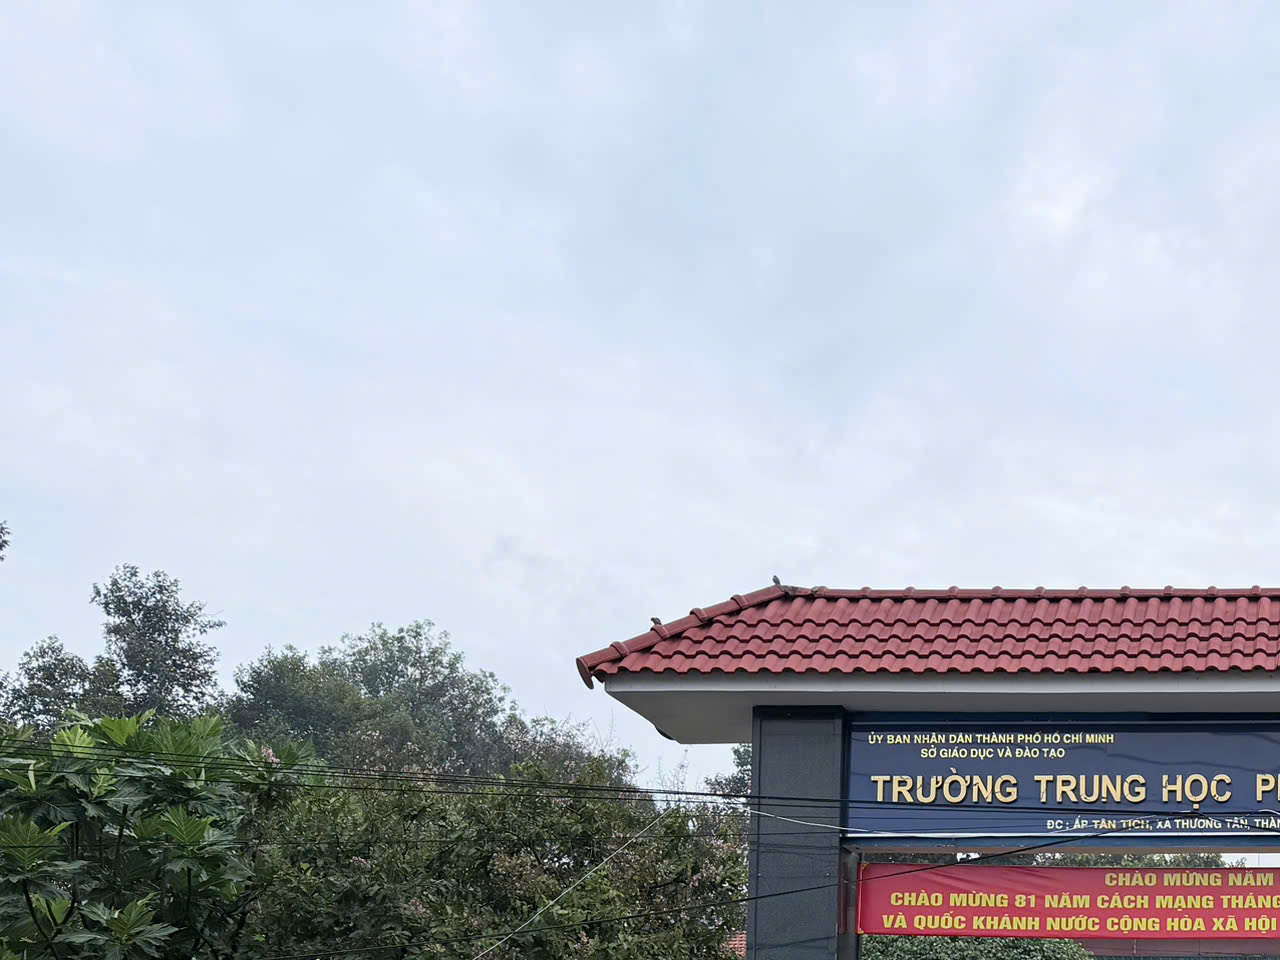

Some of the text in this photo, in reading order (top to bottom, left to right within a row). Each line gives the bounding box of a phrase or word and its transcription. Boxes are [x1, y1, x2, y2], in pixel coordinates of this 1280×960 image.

[868, 731, 1114, 744] ỦY BAN NHÂN DÂN THÀNH PHỐ HỒ CHÍ MINH
[921, 745, 1065, 760] SỞ GIÁO DỤC VÀ ĐÀO TẠO
[871, 767, 1019, 804] TRƯỜNG
[1033, 774, 1147, 803] TRUNG
[1162, 773, 1233, 810] HỌC
[1073, 814, 1088, 829] ẤP
[1092, 817, 1117, 829] TÂN
[1225, 817, 1251, 830] TÂN,
[1104, 870, 1157, 886] CHÀO
[1163, 870, 1222, 887] MỪNG
[1228, 871, 1274, 886] NĂM
[890, 889, 943, 907] CHÀO
[950, 891, 1009, 908] MỪNG
[1014, 894, 1036, 908] 81
[1044, 892, 1090, 908] NĂM
[1096, 893, 1149, 909] CÁCH
[1155, 895, 1214, 911] MẠNG
[882, 912, 907, 929] VÀ
[913, 911, 966, 930] QUỐC
[972, 914, 1040, 931] KHÁNH
[1046, 914, 1100, 931] NƯỚC
[1106, 914, 1160, 933] CỘNG
[1166, 914, 1206, 931] HÒA
[1212, 914, 1238, 931] XÃ
[1244, 914, 1277, 933] HỘI
